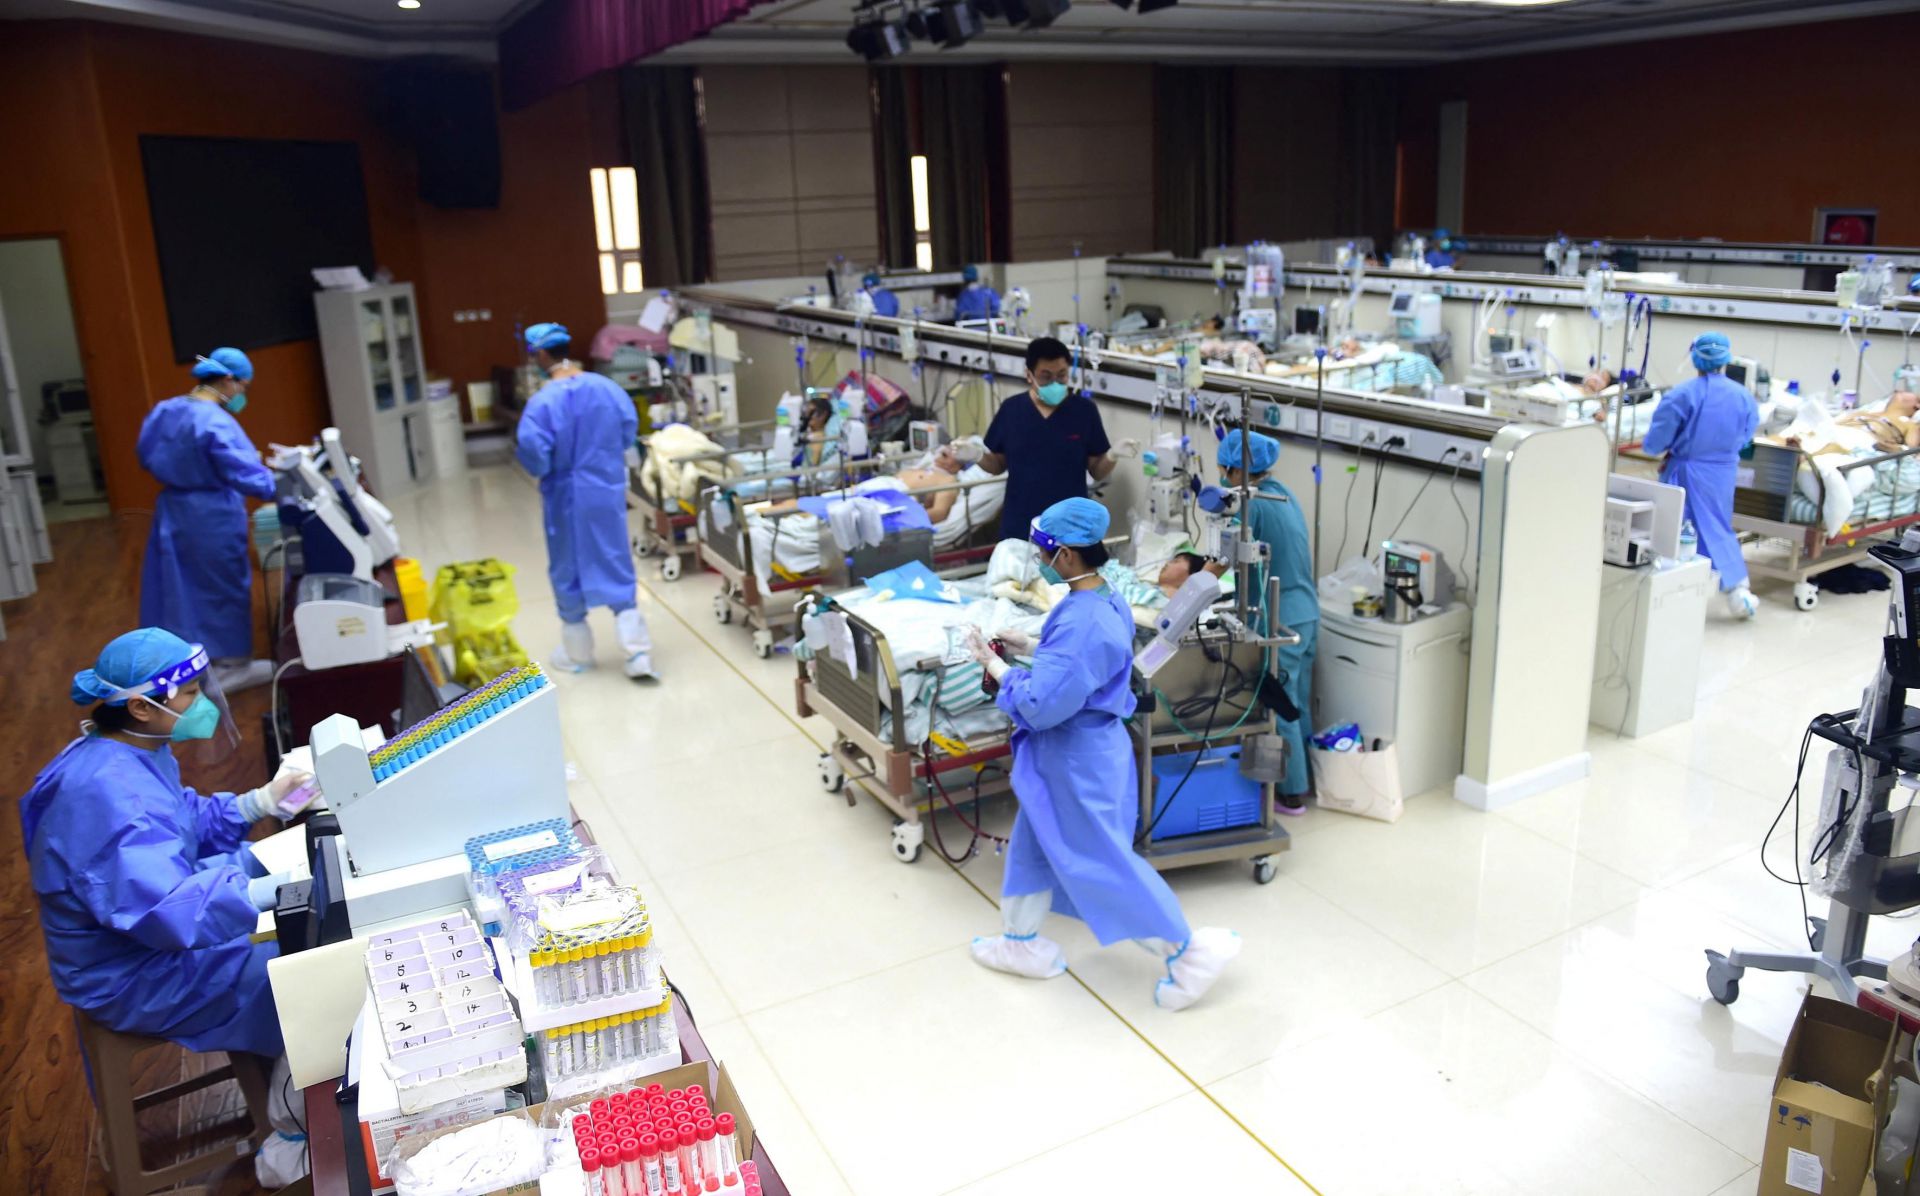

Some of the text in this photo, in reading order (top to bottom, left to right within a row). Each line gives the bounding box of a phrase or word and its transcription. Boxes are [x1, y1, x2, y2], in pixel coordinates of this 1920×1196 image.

[441, 923, 448, 932] 8
[448, 935, 454, 945] 9
[385, 950, 394, 961] 6
[452, 950, 463, 961] 10
[397, 964, 405, 977] 5
[457, 970, 470, 979] 12
[400, 982, 410, 994] 4
[461, 986, 472, 997] 13
[407, 1001, 417, 1013] 3
[467, 1003, 480, 1014] 14
[396, 1022, 411, 1032] 2
